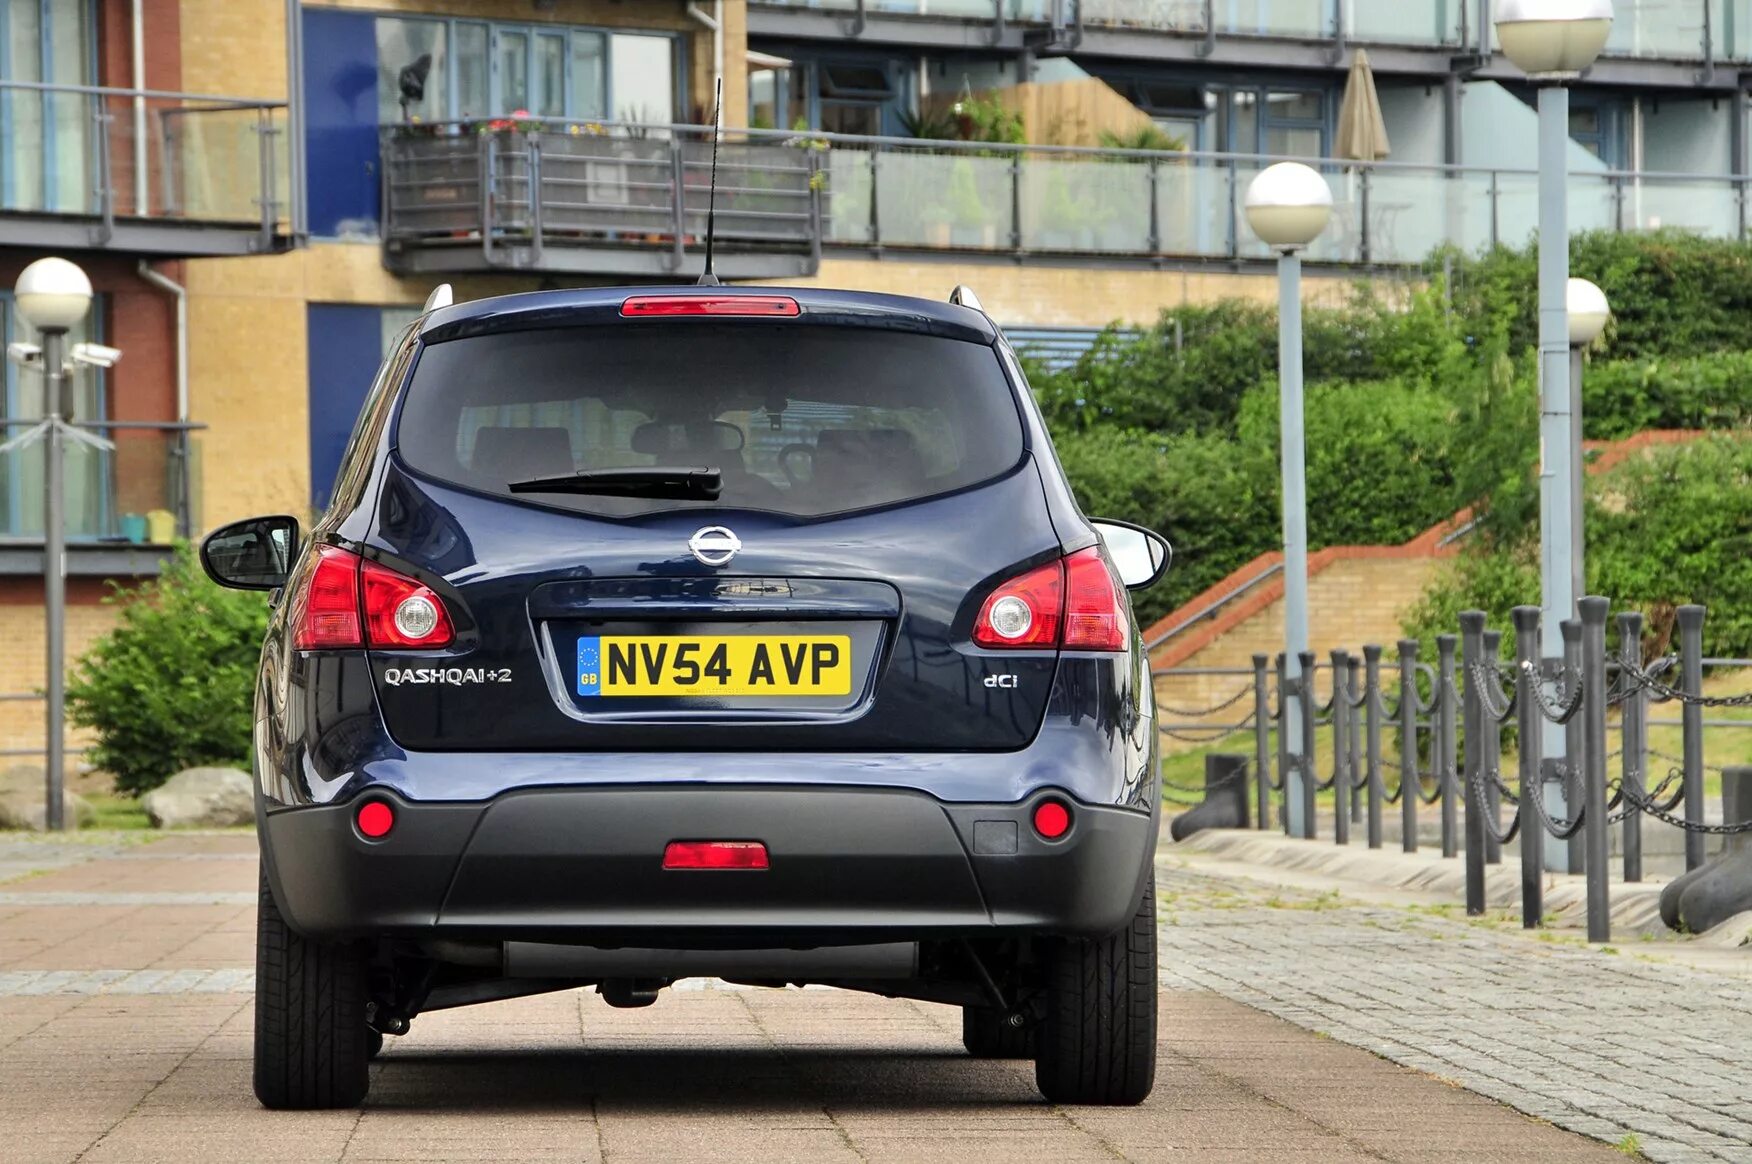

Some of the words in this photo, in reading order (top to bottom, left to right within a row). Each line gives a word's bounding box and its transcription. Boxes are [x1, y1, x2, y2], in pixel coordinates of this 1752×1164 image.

[608, 643, 732, 685] NV54
[748, 643, 839, 685] AVP
[384, 668, 512, 686] QASHQAI+2
[581, 673, 597, 685] GB
[983, 674, 1018, 688] dCi
